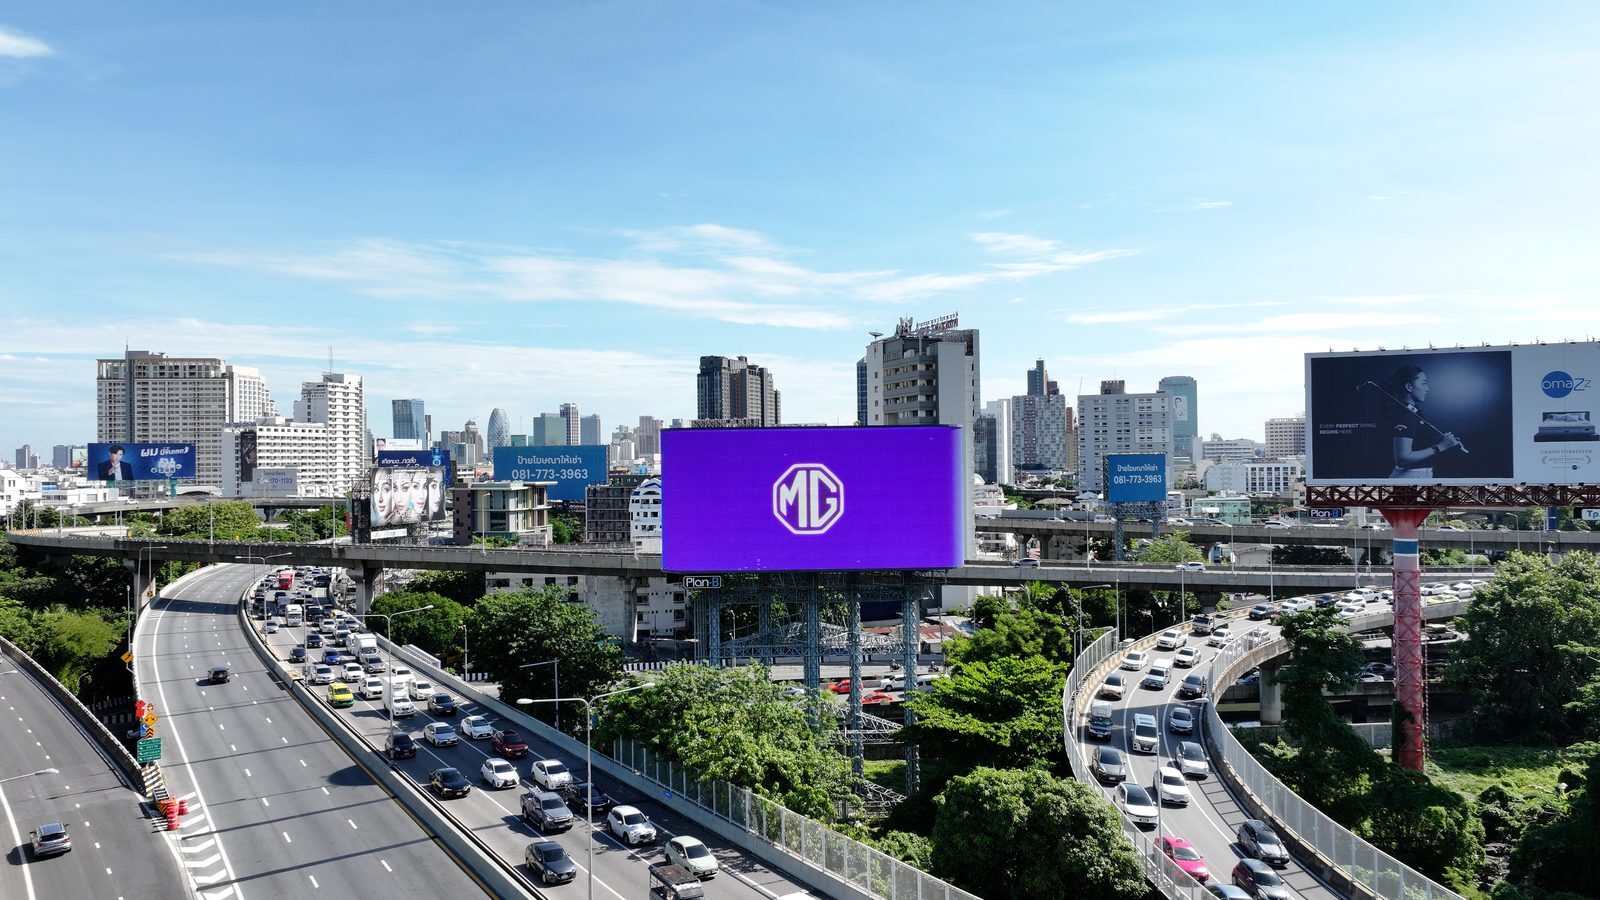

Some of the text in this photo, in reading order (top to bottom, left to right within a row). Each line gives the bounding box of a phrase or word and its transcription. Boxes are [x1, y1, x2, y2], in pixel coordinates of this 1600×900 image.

[140, 447, 159, 458] ผม
[517, 455, 582, 465] ป้ายโฆษณาให้เช่า
[511, 468, 589, 480] 081-773-3963
[1113, 474, 1162, 485] 081-773-3963
[779, 469, 838, 528] MG
